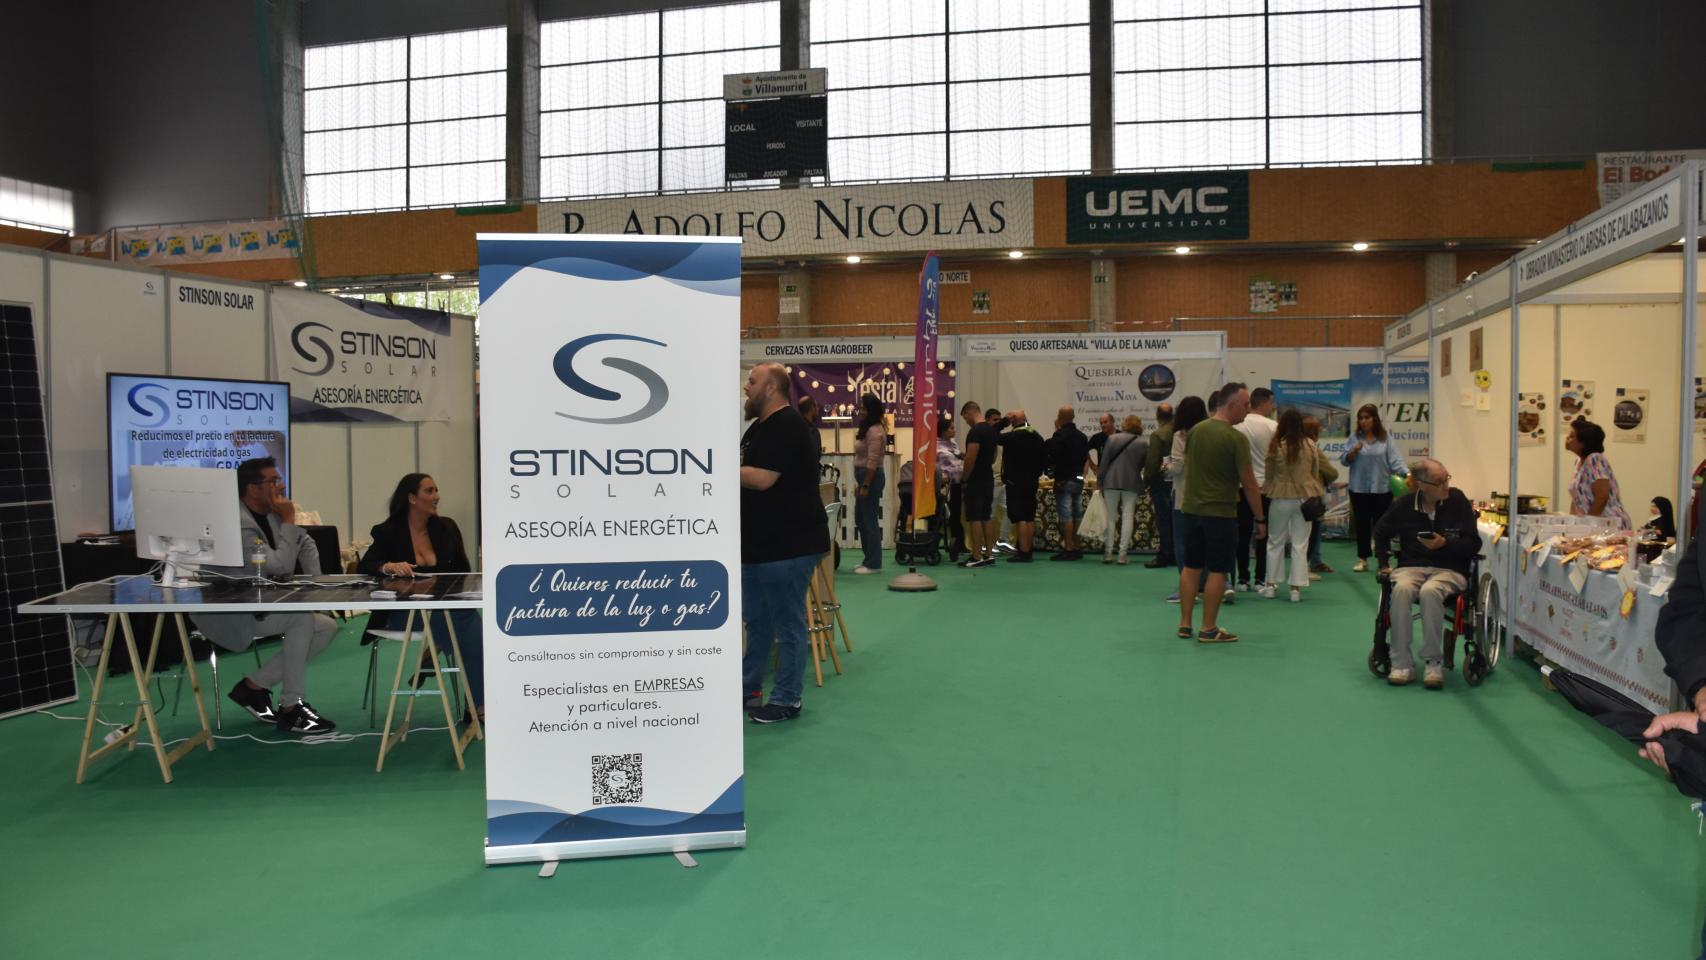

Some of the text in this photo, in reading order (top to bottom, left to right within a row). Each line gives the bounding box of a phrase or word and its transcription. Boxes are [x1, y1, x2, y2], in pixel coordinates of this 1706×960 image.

[755, 81, 807, 95] Villamuriel
[730, 123, 756, 132] LOCAL
[796, 119, 823, 128] VISITANTE
[1604, 154, 1687, 165] RESTAURANTE
[1630, 165, 1671, 182] Bod
[1085, 186, 1229, 217] UEMC
[814, 197, 1007, 241] NICOLAS
[1089, 219, 1227, 230] UNIVERSIDAD
[1525, 253, 1547, 281] OBRADOR
[1547, 236, 1578, 270] MONASTERIO
[1579, 223, 1607, 256] CLARISAS
[1607, 218, 1618, 244] DE
[1617, 193, 1669, 239] CALABAZANOS
[946, 271, 969, 282] NORTE
[178, 286, 254, 311] STINSON SOLAR
[340, 331, 436, 360] STINSON
[765, 343, 873, 357] CERVEZAS YESTA AGROBEER
[1009, 340, 1039, 352] QUESO
[1040, 340, 1089, 350] ARTESANAL
[1119, 339, 1131, 350] DE
[1133, 339, 1143, 349] LA
[341, 361, 437, 377] SOLAR
[1075, 366, 1133, 380] QUESERÍA
[847, 363, 897, 404] Yesta
[176, 389, 274, 411] STINSON
[312, 385, 423, 405] ASESORÍA ENERGÉTICA
[1076, 391, 1100, 401] VILLA
[1115, 390, 1137, 401] NAVA
[177, 414, 274, 426] SOLAR
[131, 430, 183, 441] Reducimos
[186, 430, 193, 441] el
[195, 431, 222, 444] precio
[224, 432, 233, 441] en
[163, 447, 251, 460] de electricidad o gas
[510, 448, 713, 477] STINSON
[510, 482, 713, 499] SOLAR
[504, 514, 719, 539] ASESORÍA ENERGÉTICA
[550, 568, 609, 592] Quieres
[615, 569, 674, 590] reducir
[680, 568, 698, 589] tu
[504, 590, 721, 632] factura de la luz o gas?
[507, 645, 722, 663] Consúltanos sin compromiso y sin coste
[523, 676, 705, 698] Especialistas en EMPRESAS
[567, 699, 662, 716] y particulares.
[528, 713, 700, 733] Atención a nivel nacional
